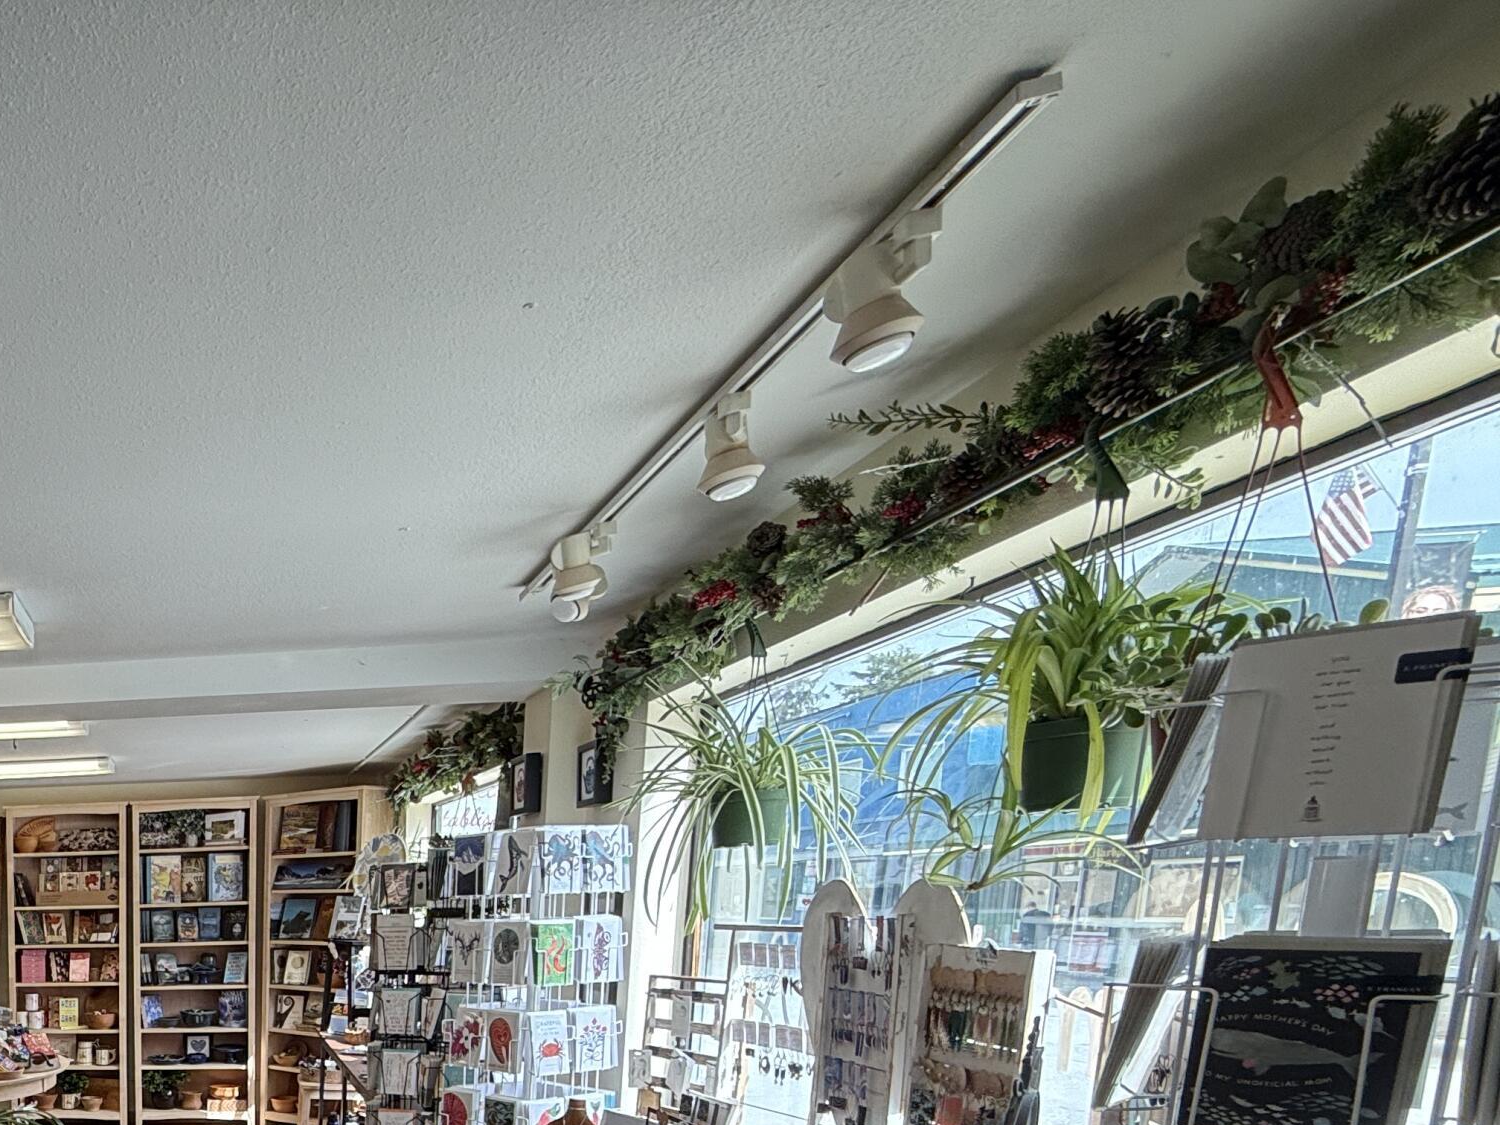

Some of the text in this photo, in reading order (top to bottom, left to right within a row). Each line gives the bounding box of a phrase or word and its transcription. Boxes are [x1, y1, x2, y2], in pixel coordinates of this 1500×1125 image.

[1254, 1012, 1308, 1028] MOTHER'S
[1311, 1023, 1337, 1037] DAY
[1236, 1077, 1299, 1089] UNOFFICIAL
